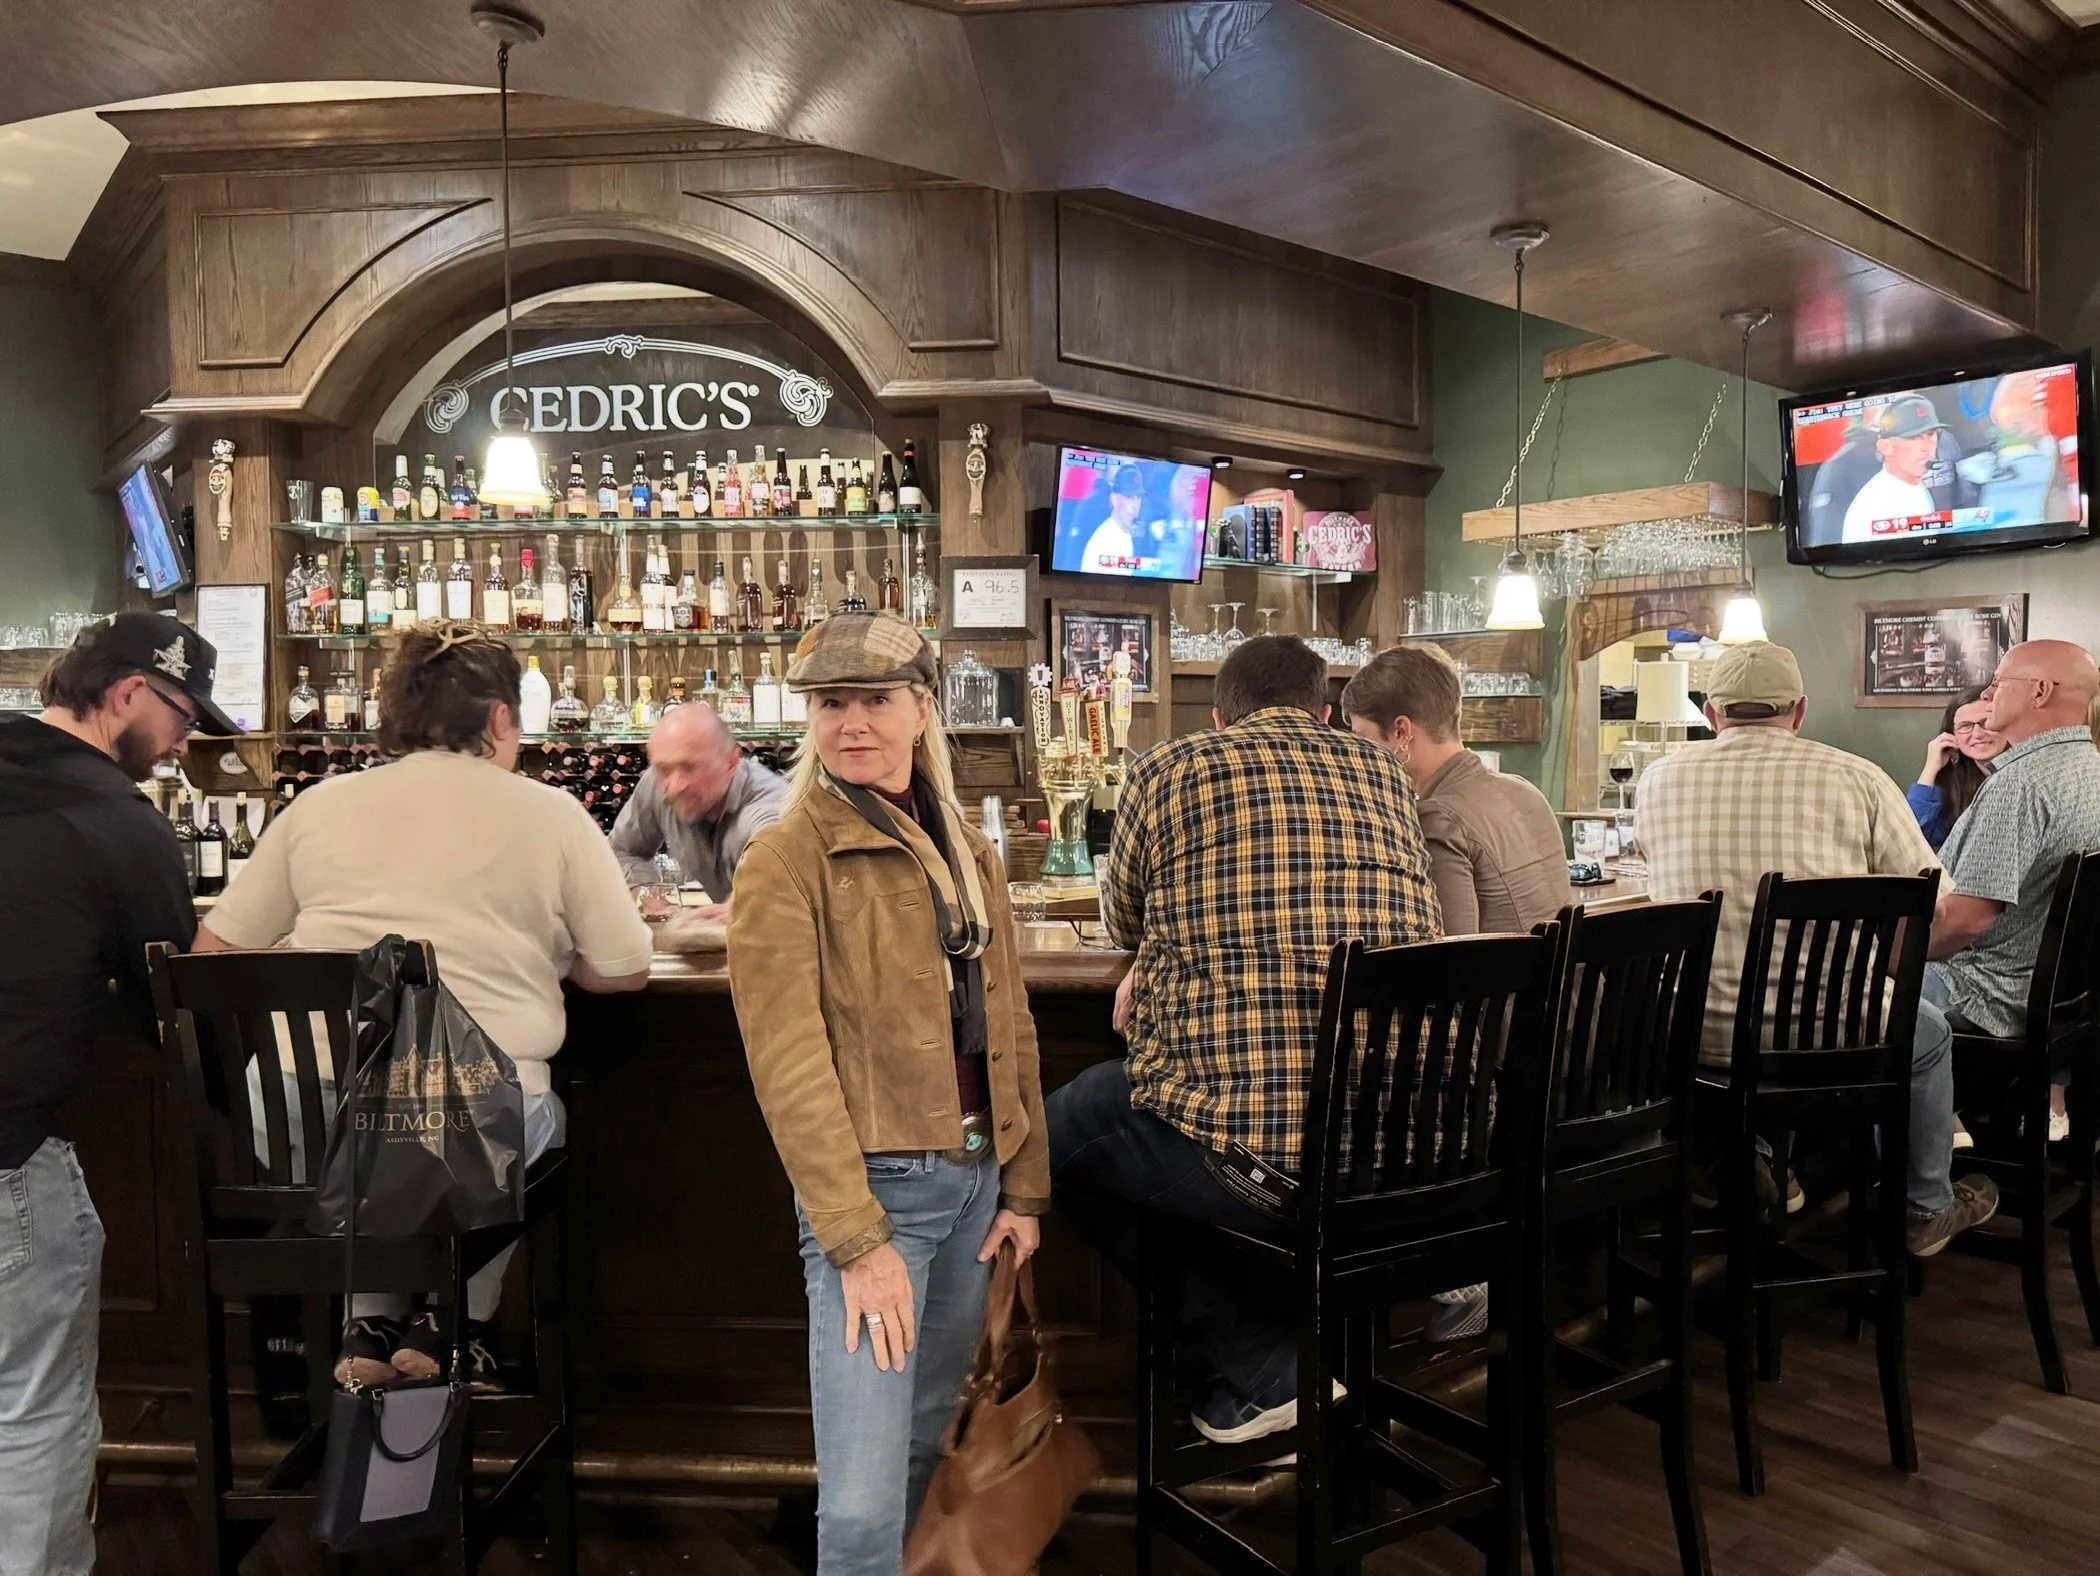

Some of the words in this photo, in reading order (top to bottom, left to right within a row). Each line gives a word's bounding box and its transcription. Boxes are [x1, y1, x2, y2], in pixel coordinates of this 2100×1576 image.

[490, 382, 752, 433] CEDRIC'S
[1308, 524, 1371, 544] CEDRIC'S
[962, 581, 974, 592] A
[984, 580, 1020, 593] 96.5
[1089, 707, 1099, 736] GAELIC
[355, 1111, 471, 1132] BILTMORE
